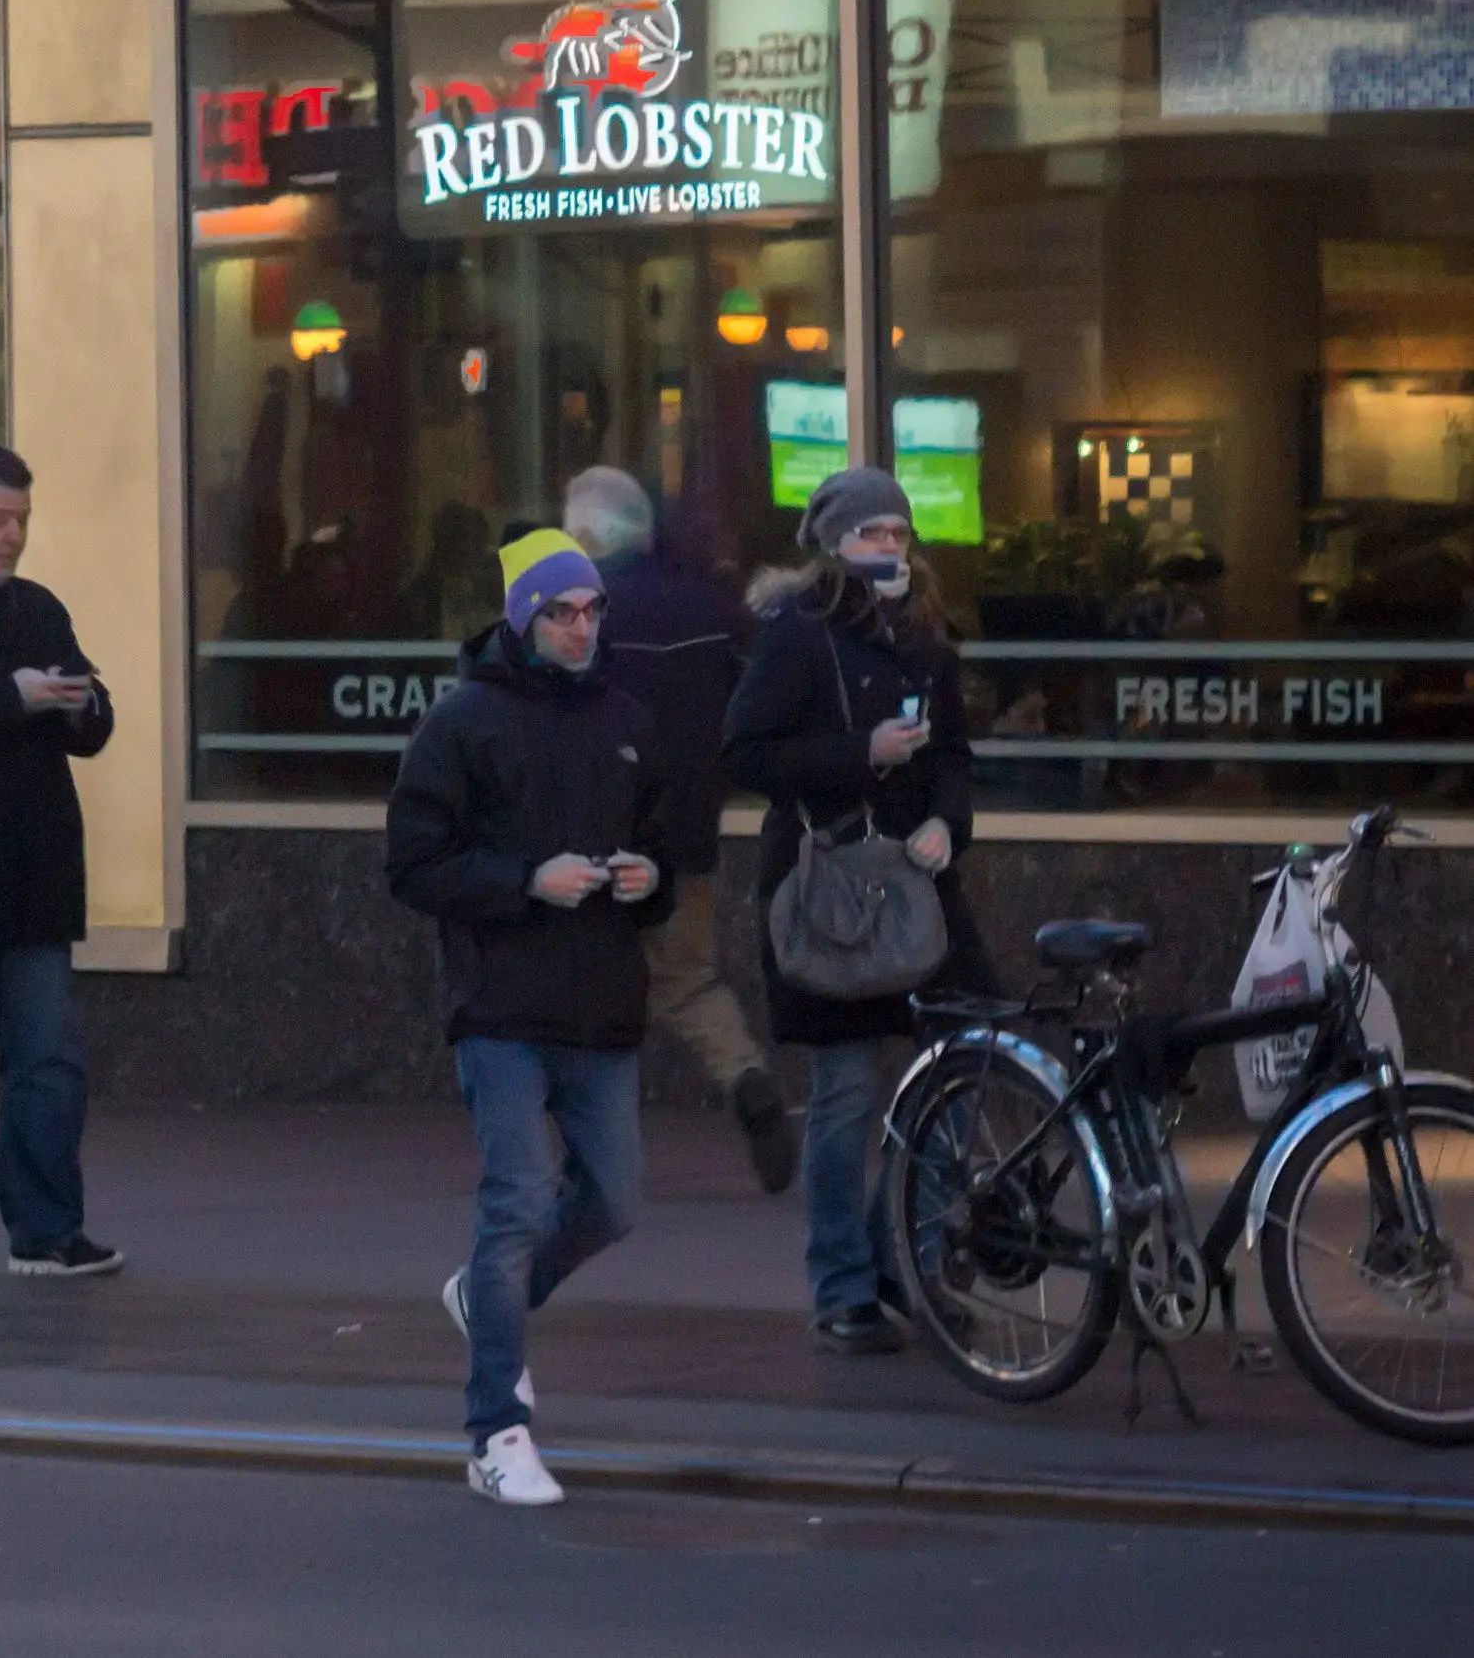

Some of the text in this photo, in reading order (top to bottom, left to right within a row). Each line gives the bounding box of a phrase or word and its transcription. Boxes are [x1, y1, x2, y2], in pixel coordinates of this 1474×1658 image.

[415, 115, 547, 205] RED
[557, 94, 829, 180] LOBSTER
[485, 180, 762, 222] FRESH FISH LIVE LOBSTER
[1115, 676, 1383, 725] FRESH FISH
